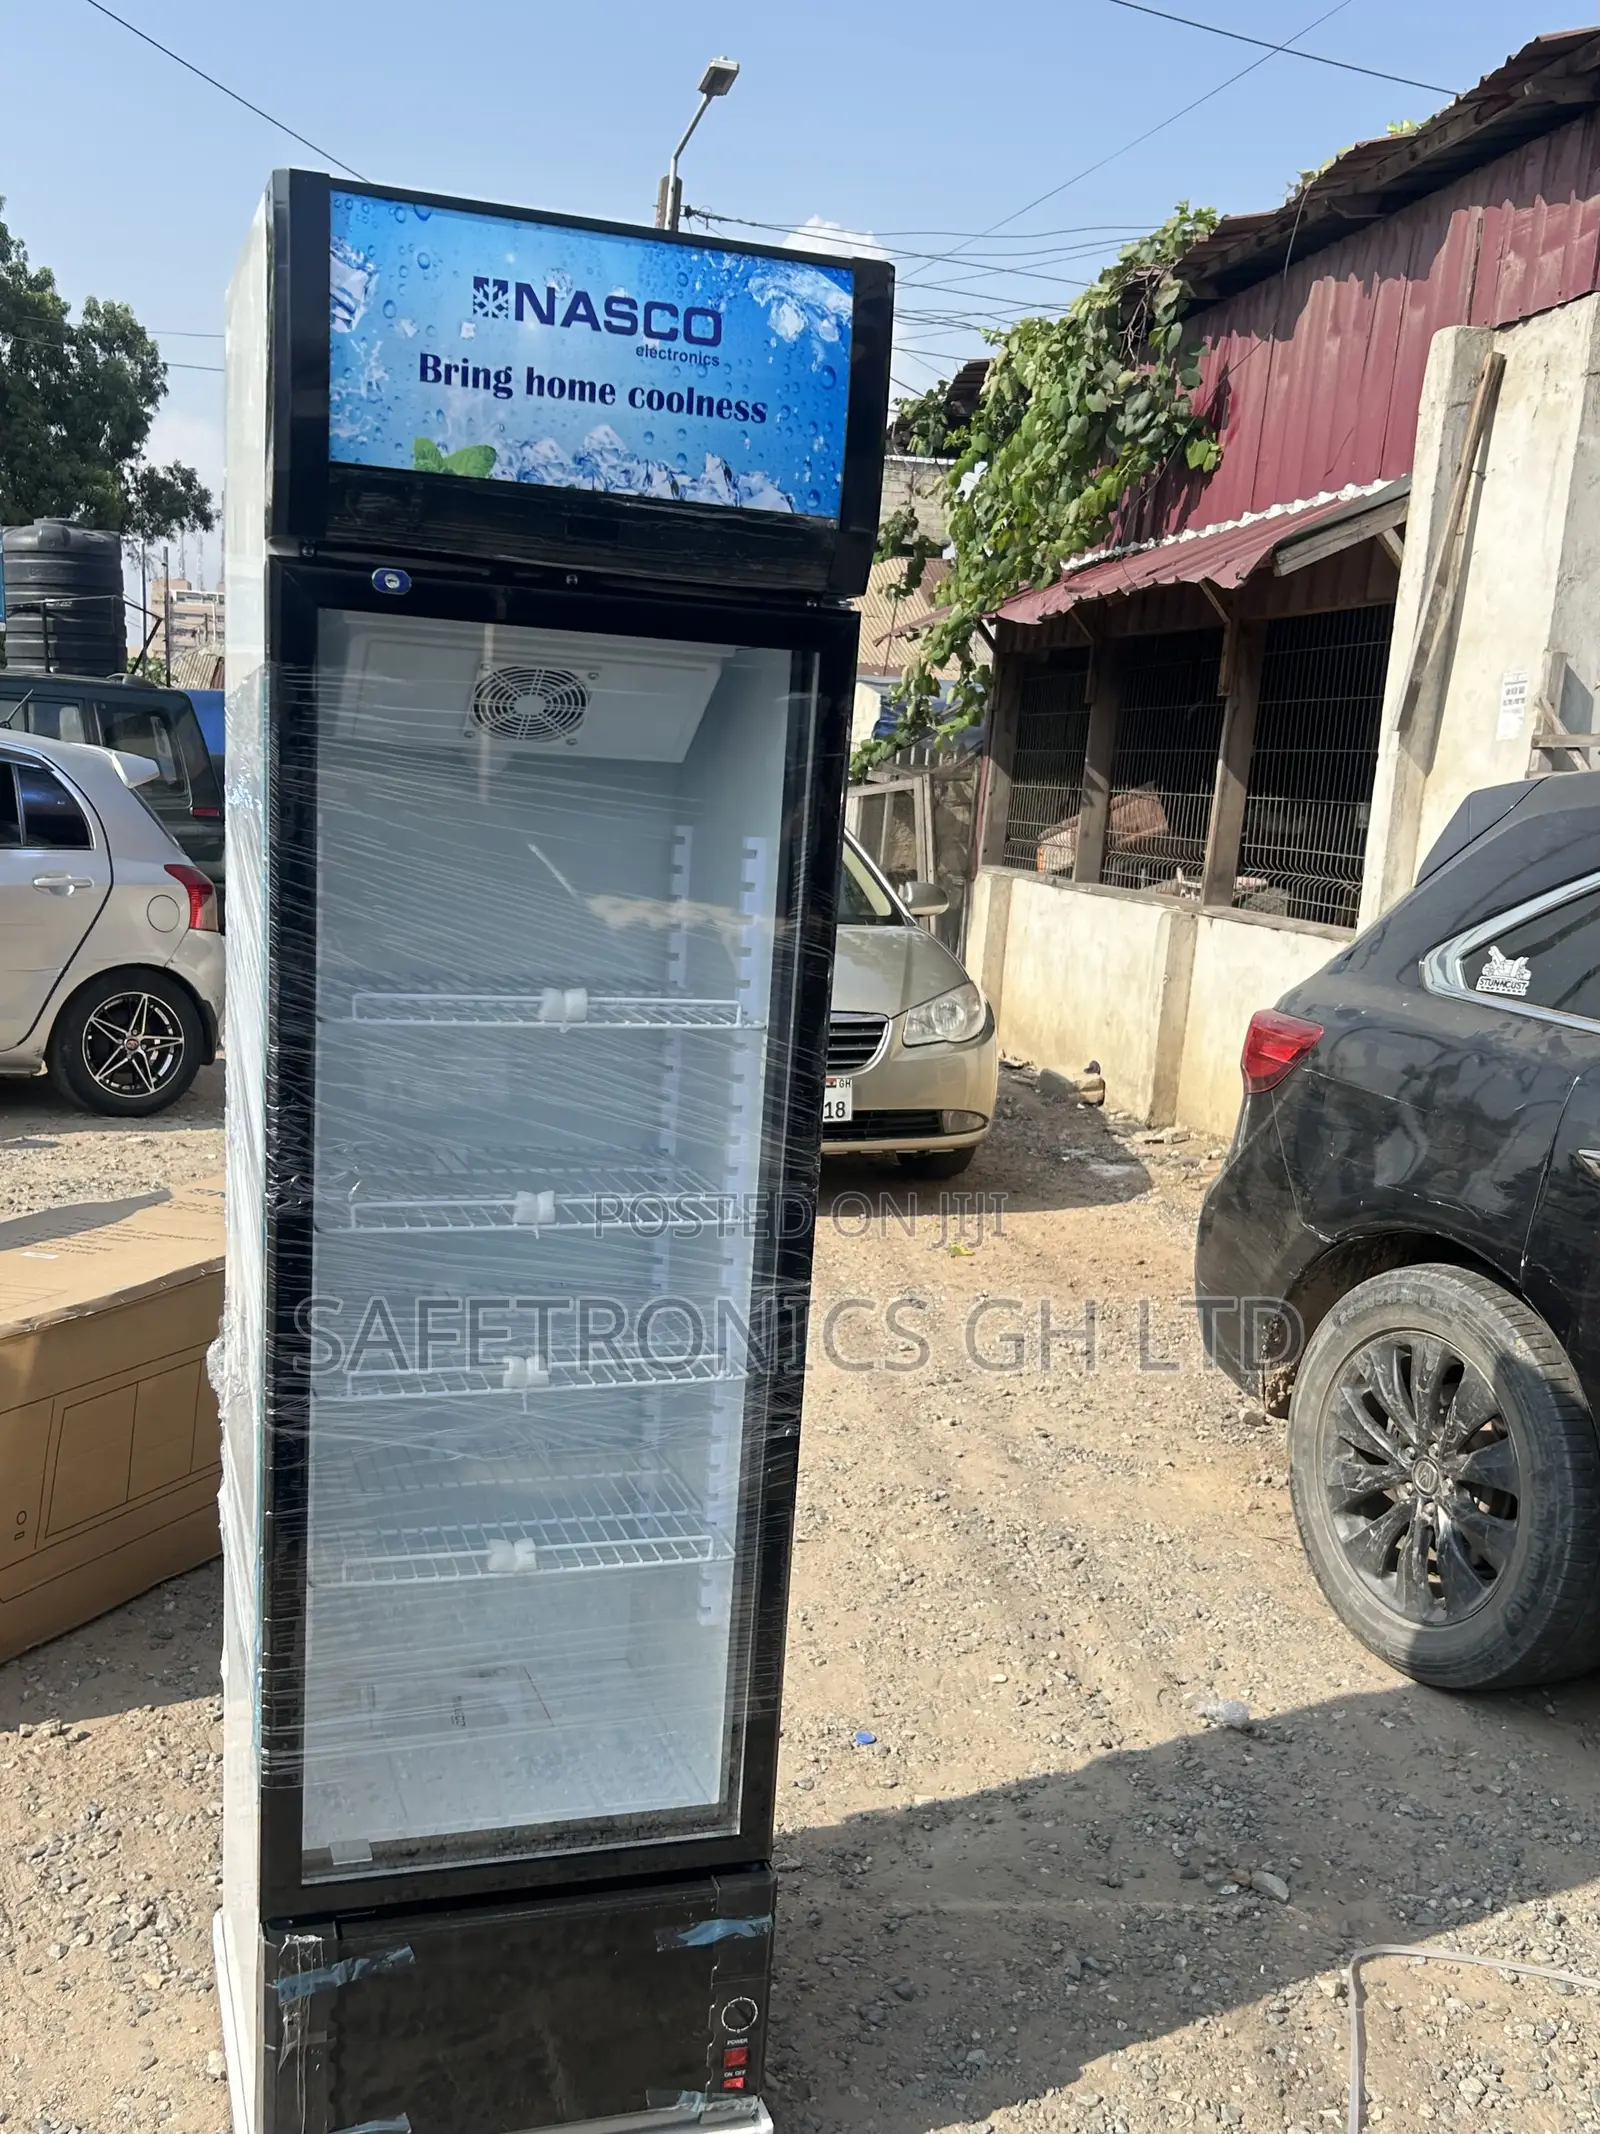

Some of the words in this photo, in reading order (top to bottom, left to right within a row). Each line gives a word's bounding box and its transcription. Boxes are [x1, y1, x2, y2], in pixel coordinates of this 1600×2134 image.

[513, 281, 723, 348] NASCO
[635, 343, 721, 368] electronics
[418, 352, 514, 401] Bring
[525, 366, 616, 406] home
[627, 385, 768, 425] coolness
[839, 1078, 851, 1088] GH
[824, 1101, 846, 1119] 18
